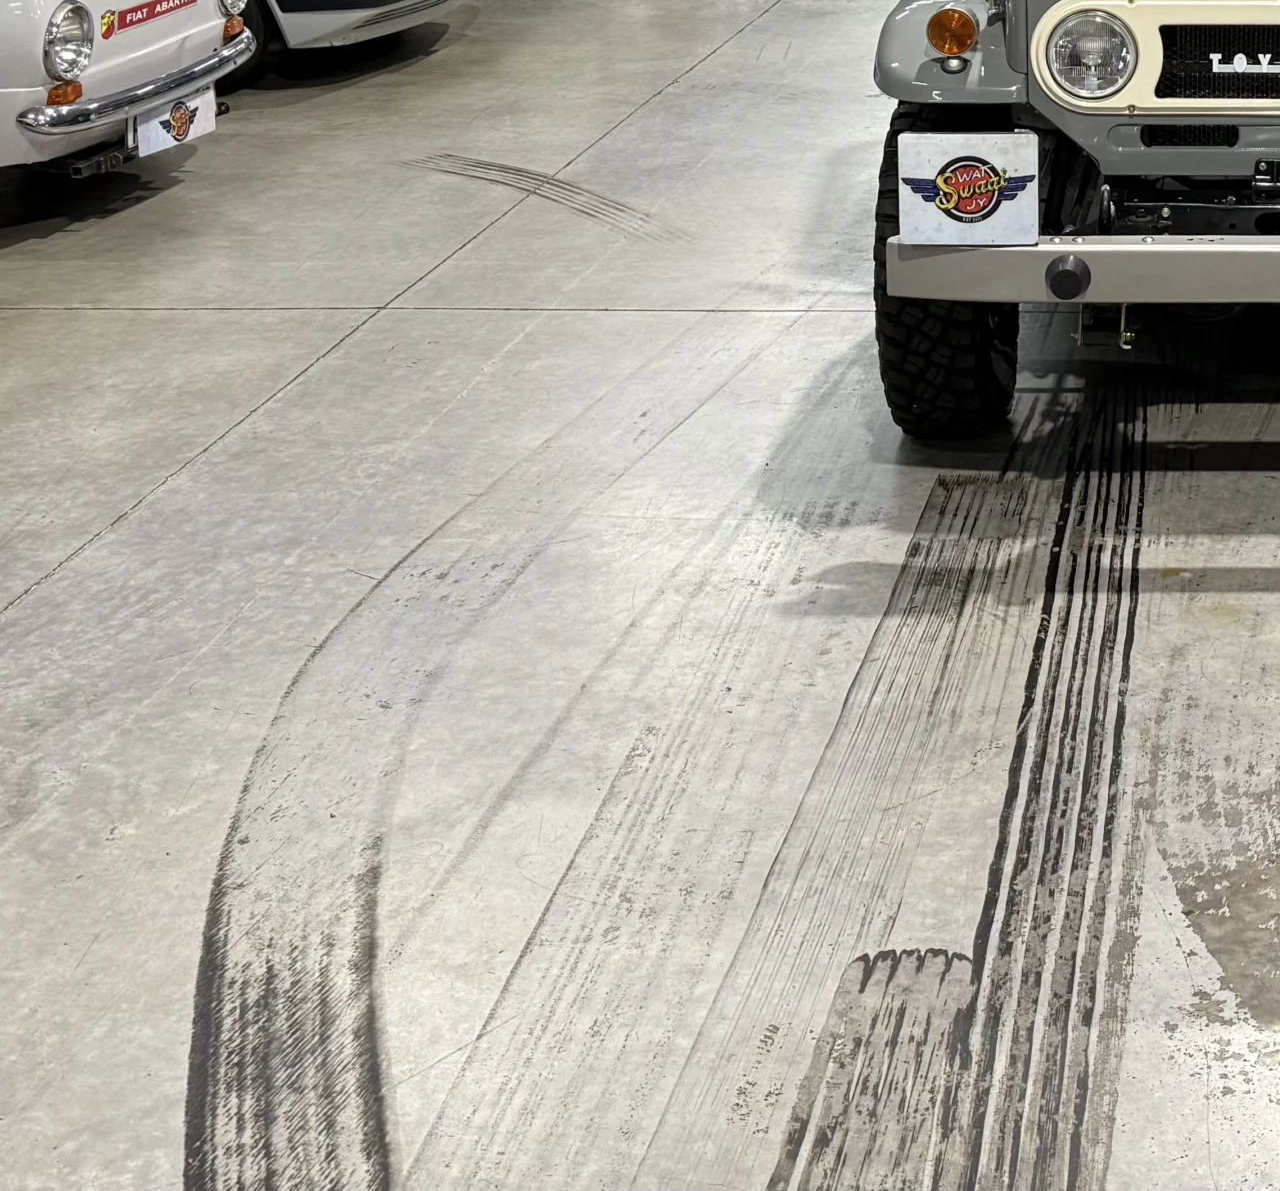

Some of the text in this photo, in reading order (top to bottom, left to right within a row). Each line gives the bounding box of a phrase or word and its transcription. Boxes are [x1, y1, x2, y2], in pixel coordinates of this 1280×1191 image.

[126, 8, 149, 24] FIAT
[956, 164, 993, 183] WAT
[966, 197, 987, 210] JY
